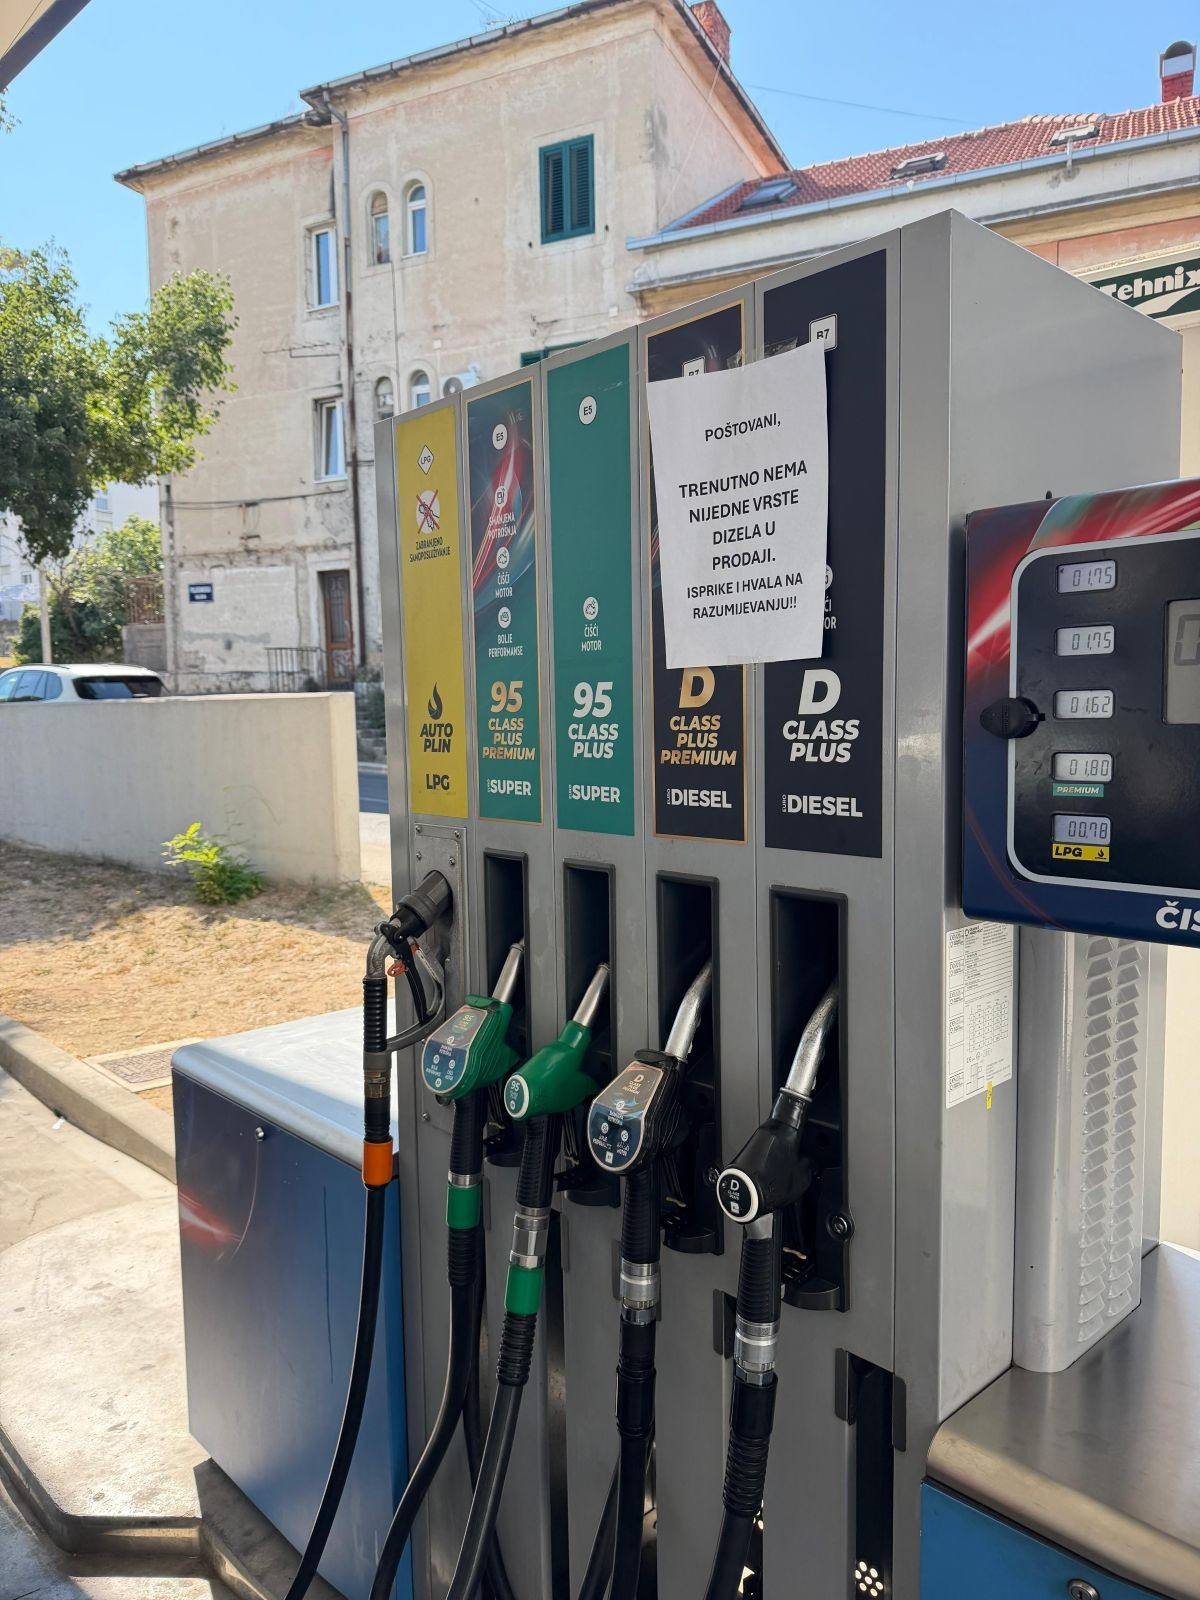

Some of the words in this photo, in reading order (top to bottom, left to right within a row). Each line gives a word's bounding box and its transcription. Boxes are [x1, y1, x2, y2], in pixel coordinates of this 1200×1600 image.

[583, 405, 593, 415] E5
[705, 413, 781, 442] POŠTOVANI,
[496, 432, 504, 441] E5
[420, 455, 432, 465] LPG
[679, 471, 760, 498] TRENUTNO
[763, 460, 808, 482] NEMA
[689, 499, 750, 523] NIJEDNE
[753, 489, 799, 512] VRSTE
[713, 524, 762, 545] DIZELA
[765, 521, 776, 536] U
[415, 536, 443, 550] ZABRANJENO
[712, 548, 776, 571] PRODAJI.
[495, 587, 513, 598] MOTOR
[687, 582, 733, 599] ISPRIKE
[737, 579, 740, 593] I
[742, 575, 783, 592] HVALA
[785, 572, 803, 586] NA
[693, 596, 797, 620] RAZUMIJEVANJU!!
[584, 623, 599, 637] ČIŠĆI
[497, 633, 513, 645] BOLJE
[581, 640, 602, 652] MOTOR
[488, 645, 524, 658] PERFORMANSE
[678, 666, 716, 709] D
[798, 668, 842, 715] D
[490, 680, 524, 713] 95
[572, 681, 613, 718] 95
[1070, 696, 1111, 714] 01,62
[420, 723, 454, 738] AUTO
[488, 717, 525, 731] CLASS
[669, 714, 721, 731] CLASS
[782, 719, 860, 740] CLASS
[493, 732, 523, 746] PLUS
[568, 723, 619, 740] CLASS
[676, 732, 718, 748] PLUS
[423, 738, 452, 753] PLIN
[482, 746, 536, 761] PREMIUM
[573, 741, 614, 759] PLUS
[789, 742, 852, 763] PLUS
[660, 749, 737, 766] PREMIUM
[1069, 759, 1110, 777] 01,80
[426, 773, 450, 791] LPG
[490, 779, 532, 796] SUPER
[1056, 786, 1100, 794] PREMIUM
[572, 784, 620, 803] SUPER
[671, 788, 732, 809] DIESEL
[787, 794, 863, 818] DIESEL
[1054, 846, 1083, 857] LPG
[511, 1080, 520, 1091] 95
[633, 1074, 645, 1083] D
[730, 1179, 740, 1191] D
